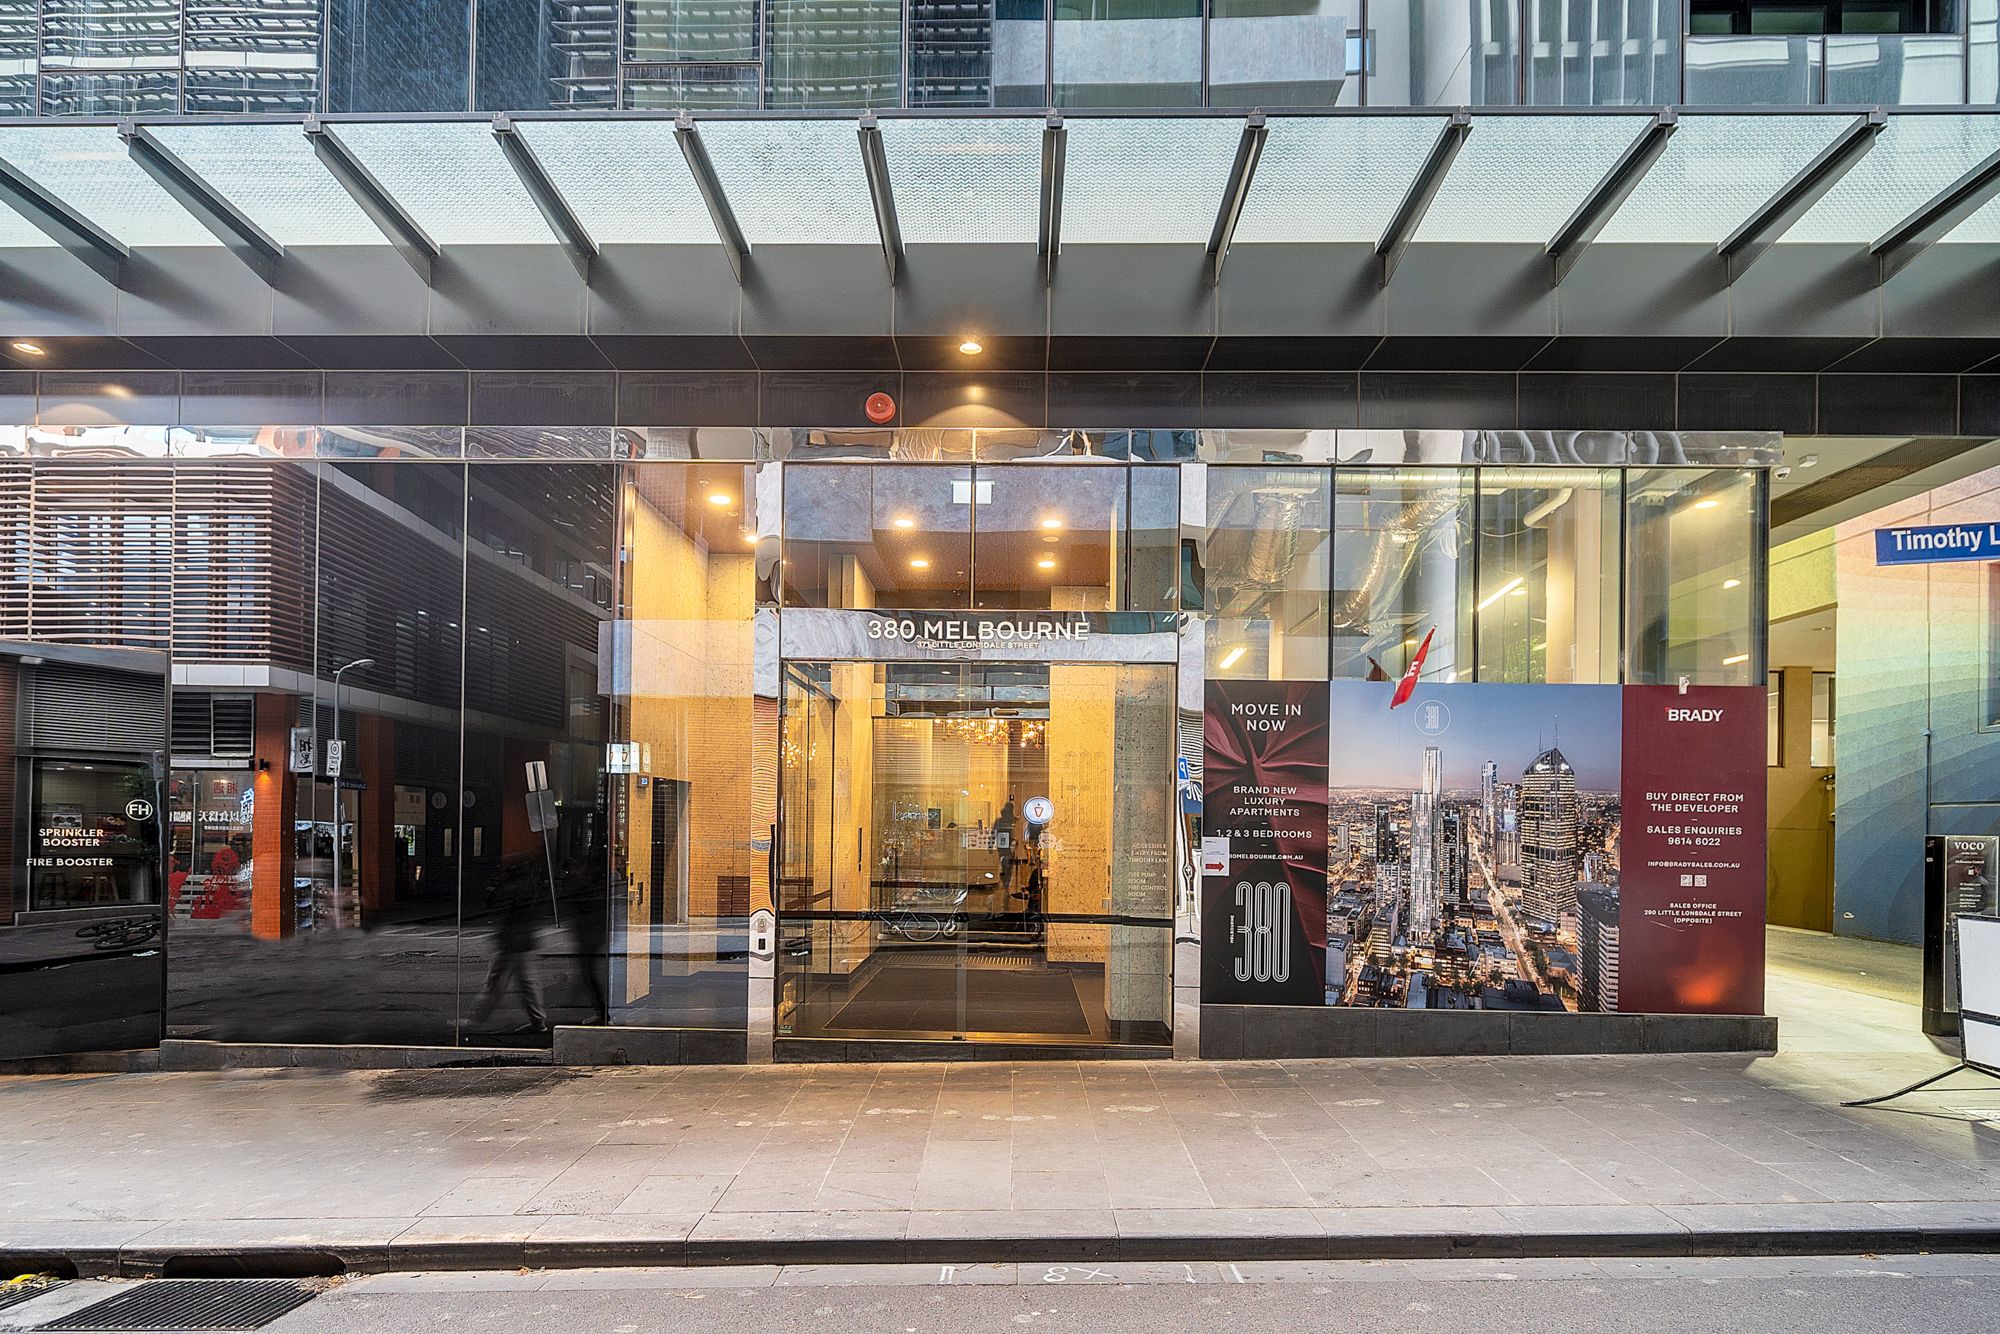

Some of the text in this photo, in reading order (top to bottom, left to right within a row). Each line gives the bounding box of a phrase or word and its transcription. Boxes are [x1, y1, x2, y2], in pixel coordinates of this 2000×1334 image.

[1891, 526, 1983, 552] Timothy
[868, 619, 1090, 641] 380 MELBOURNE
[1231, 703, 1302, 716] MOVE IN
[1667, 709, 1724, 722] BRADY
[1246, 720, 1286, 732] NOW
[1233, 786, 1297, 795] BRAND NEW
[1244, 797, 1286, 805] LUXURY
[1646, 792, 1744, 803] BUY DIRECT FROM
[129, 804, 150, 815] FH
[1229, 807, 1300, 817] APARTMENTS
[1651, 803, 1739, 813] THE DEVELOPER
[38, 828, 104, 837] SPRINKLER
[1226, 829, 1233, 837] 2
[1234, 829, 1242, 837] &
[1243, 829, 1250, 838] 3
[1253, 830, 1313, 839] BEDROOMS
[1646, 825, 1742, 836] SALES ENQUIRIES
[43, 838, 100, 847] BOOSTER
[1667, 837, 1721, 846] 9614 6022
[26, 858, 114, 867] FIRE BOOSTER
[1647, 861, 1741, 869] INFO@BRADYSALES.COM.AU
[1669, 902, 1717, 910] SALES OFFICE
[1717, 910, 1743, 918] STREET
[1673, 917, 1713, 925] (OPPOSITE)
[1234, 881, 1291, 983] 380
